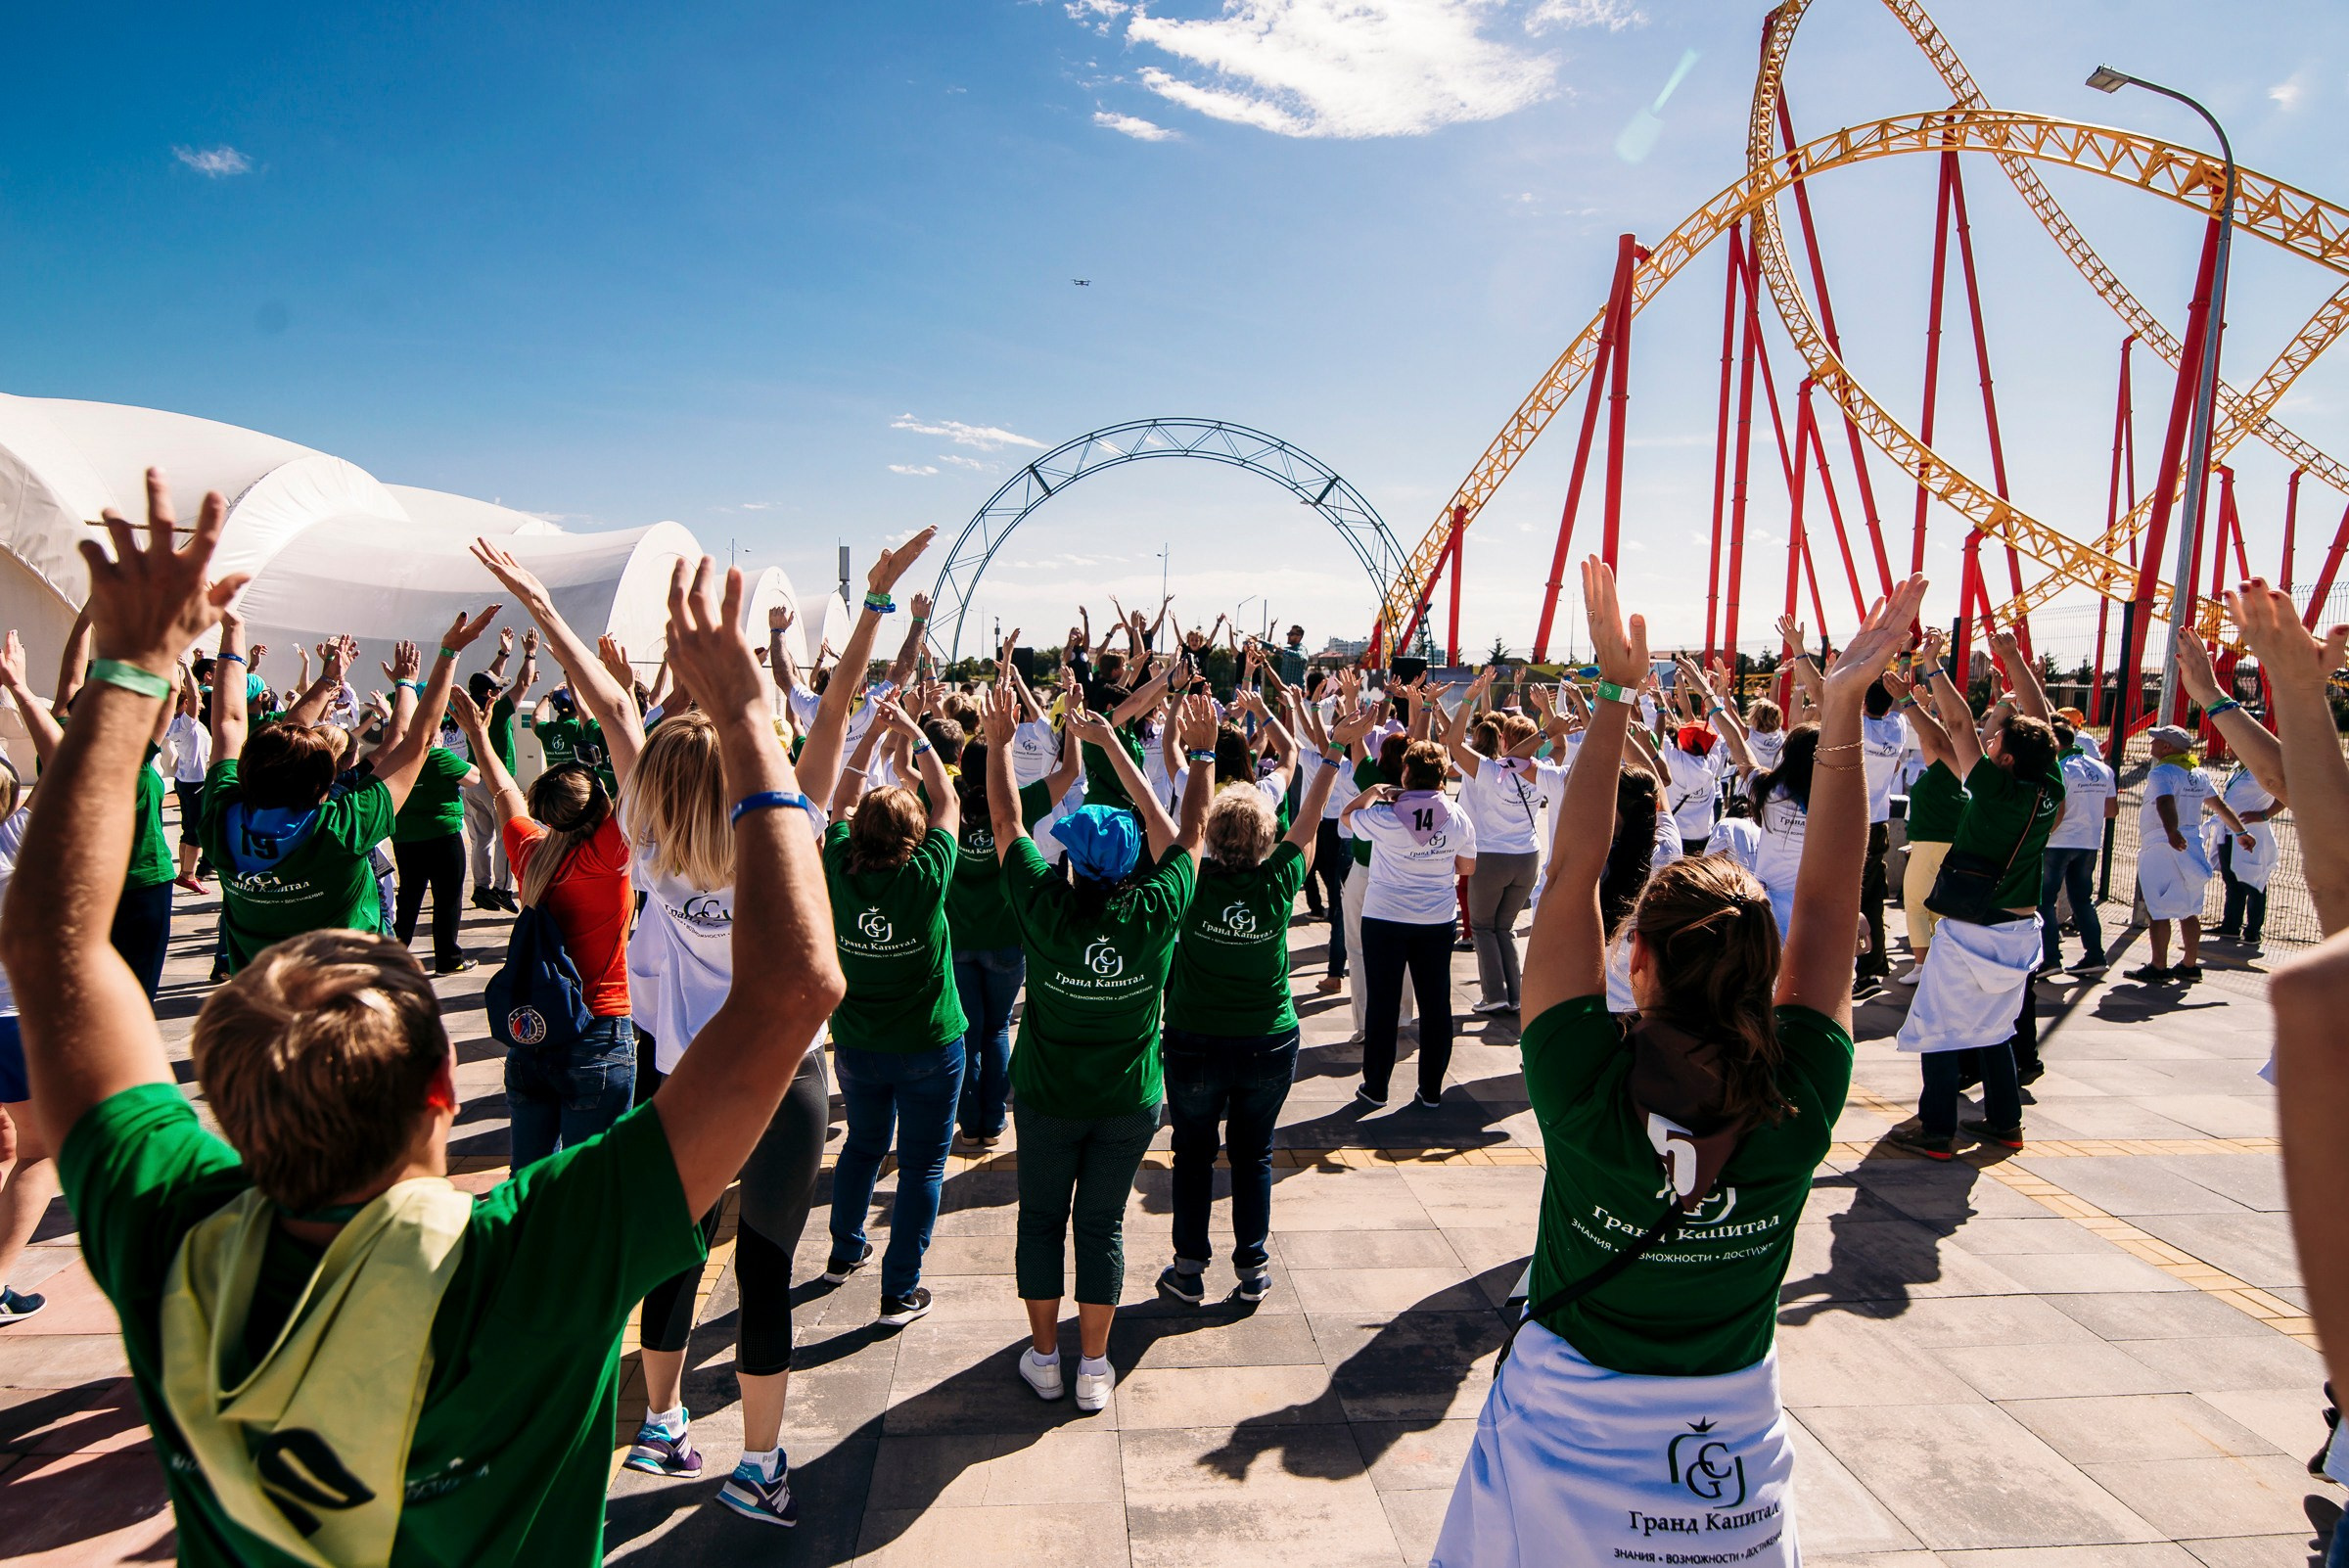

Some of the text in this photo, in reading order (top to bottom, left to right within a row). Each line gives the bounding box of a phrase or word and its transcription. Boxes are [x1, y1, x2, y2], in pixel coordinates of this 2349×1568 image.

[1412, 808, 1433, 831] 14
[1202, 920, 1273, 940] Гранд Капитал
[840, 935, 868, 949] Гранд
[870, 938, 917, 950] Капитал
[1055, 971, 1145, 989] Гранд Капитал
[1118, 985, 1154, 1000] ДОСТИЖЕНИЯ
[1676, 1215, 1779, 1241] Капитал
[1571, 1218, 1612, 1251] ЗНАНИЯ
[1637, 1252, 1712, 1263] ЗМОЖНОСТИ
[1629, 1501, 1779, 1537] Гранд Капитал
[1614, 1547, 1656, 1563] ЗНАНИЯ
[1666, 1552, 1739, 1564] ВОЗМОЖНОСТИ
